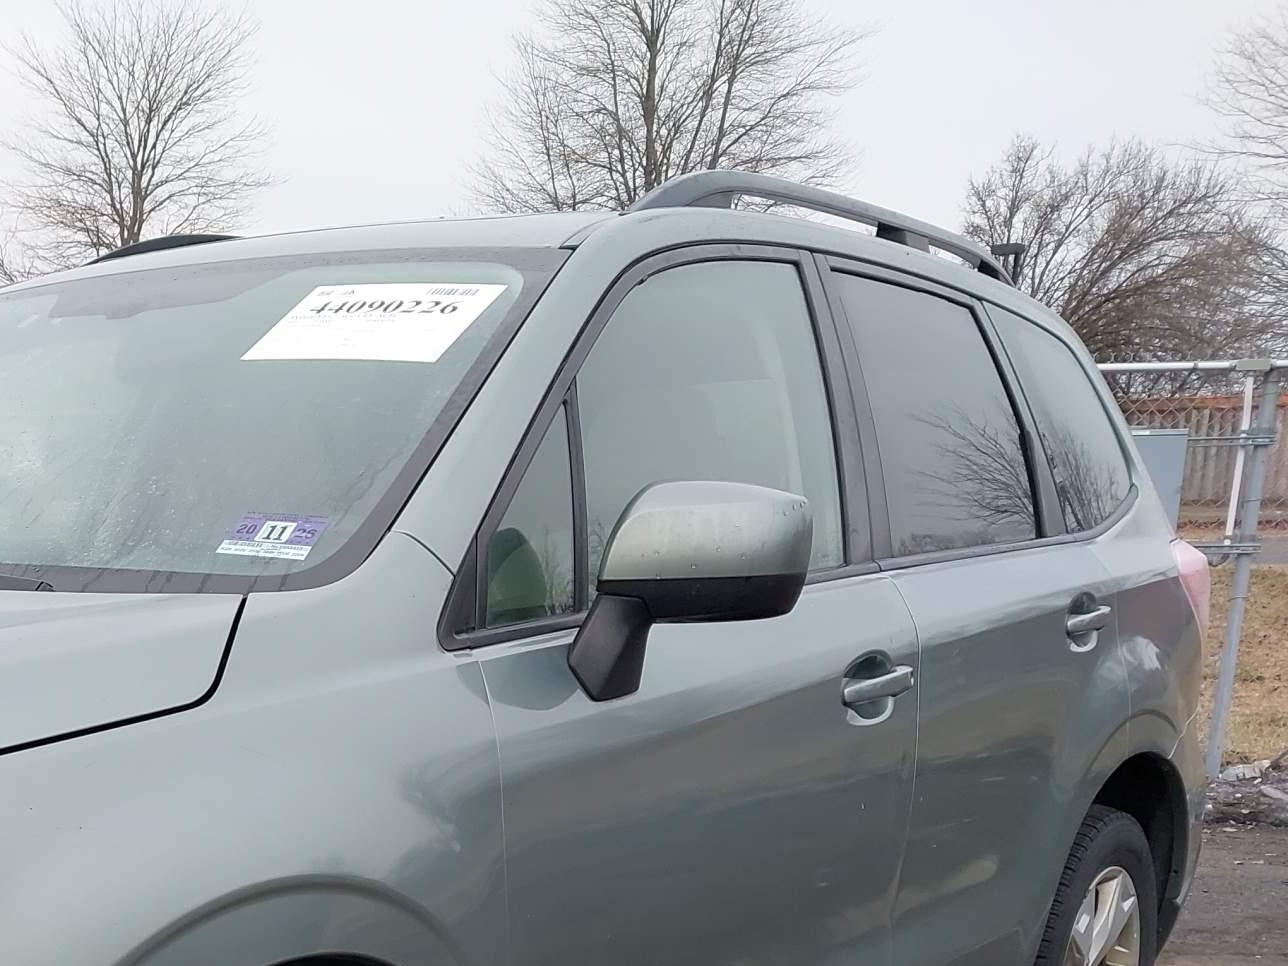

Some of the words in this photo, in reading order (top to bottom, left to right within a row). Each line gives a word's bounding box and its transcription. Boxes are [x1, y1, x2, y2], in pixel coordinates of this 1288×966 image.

[309, 300, 461, 315] 44090226
[236, 524, 258, 535] 20
[262, 524, 288, 541] 11
